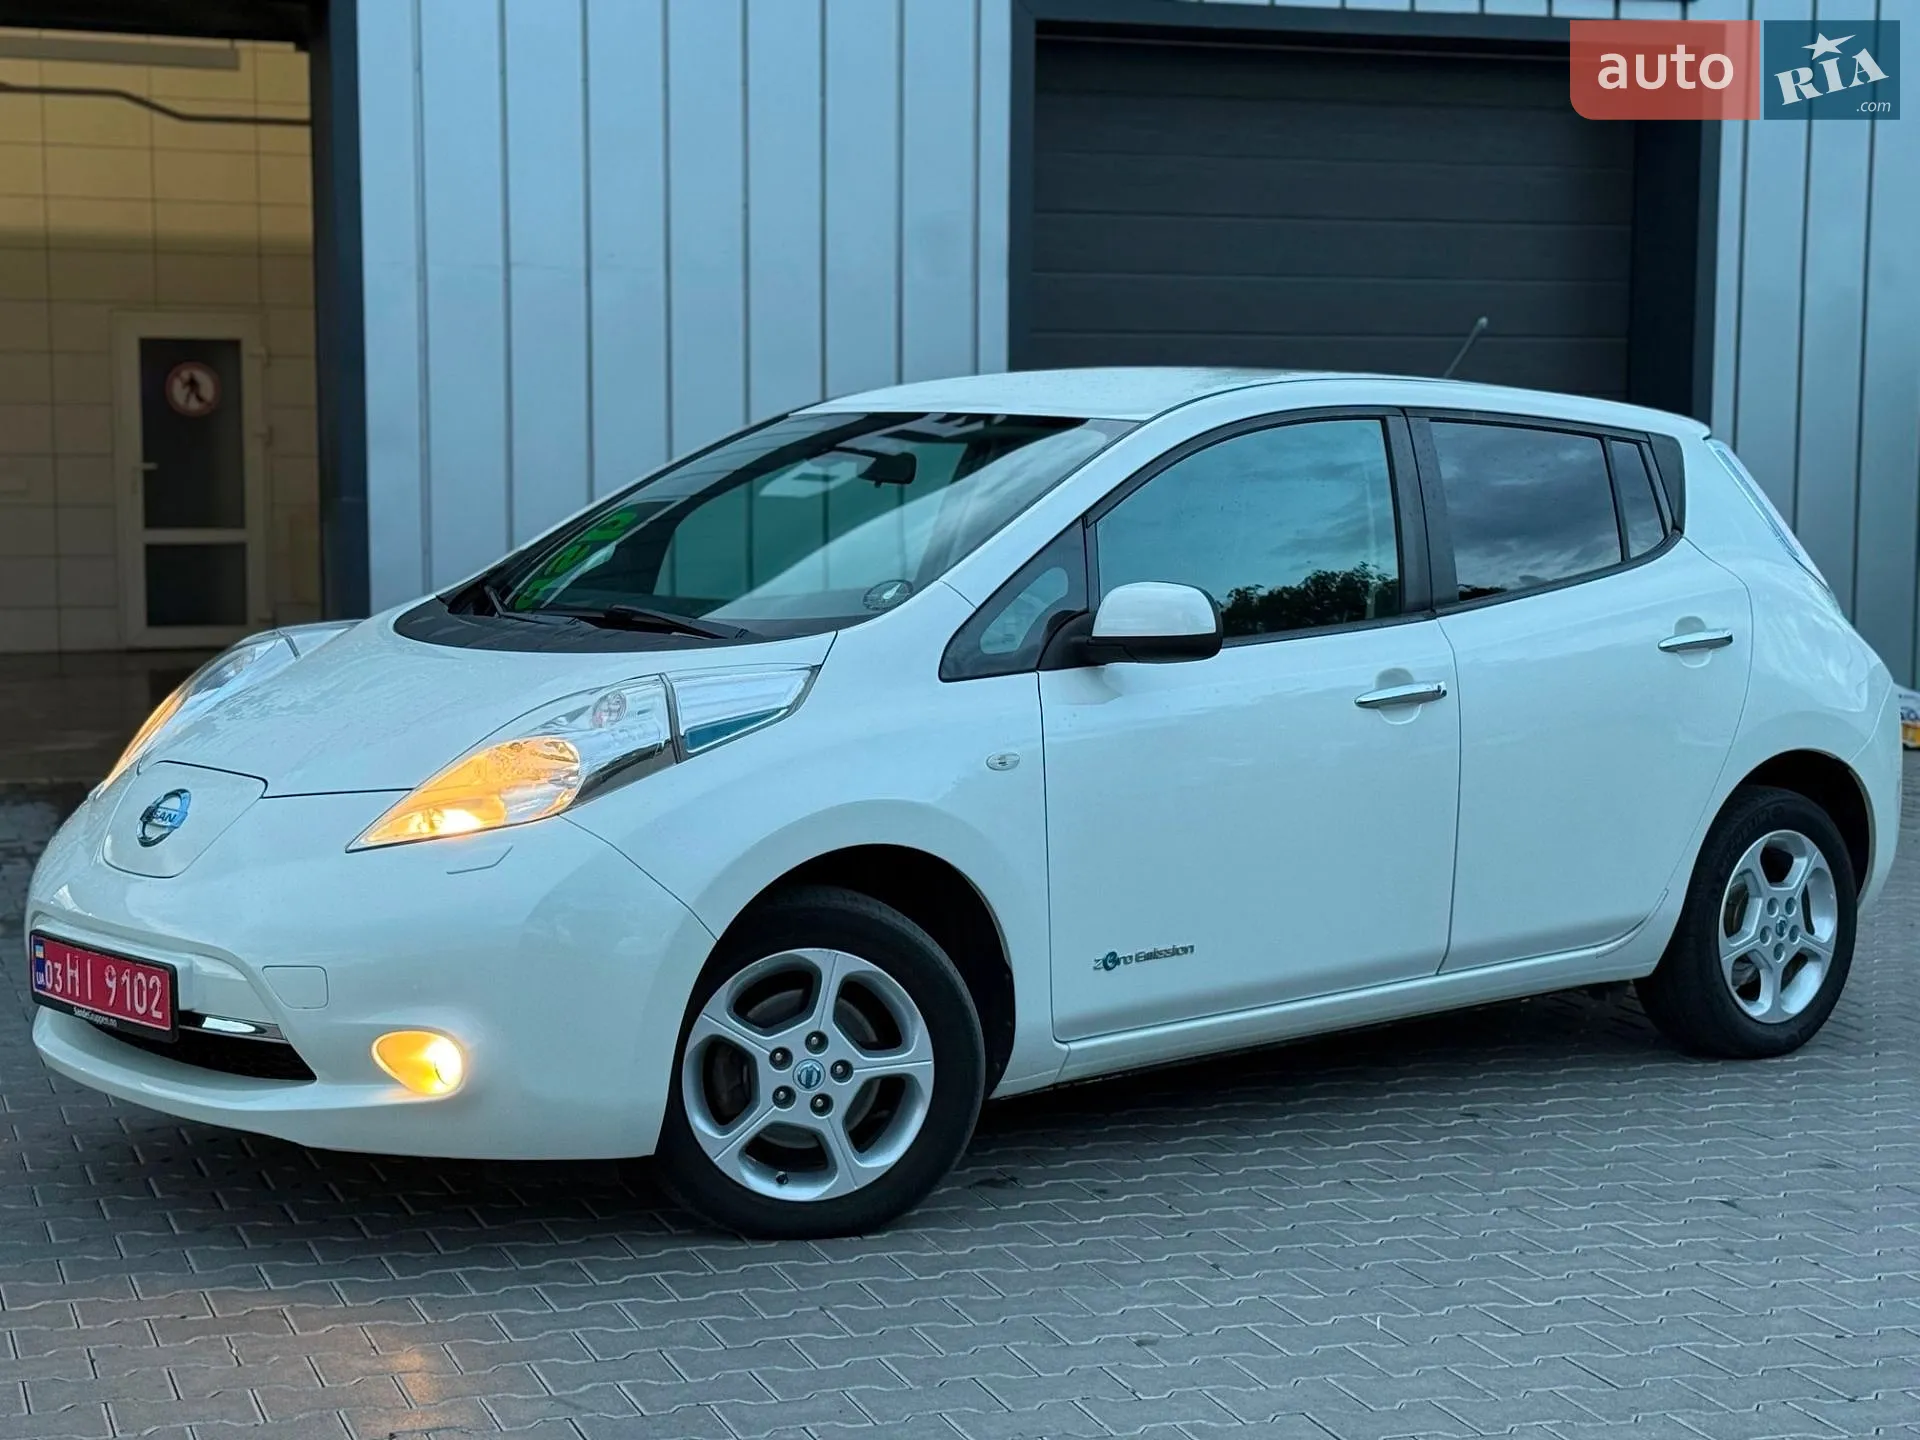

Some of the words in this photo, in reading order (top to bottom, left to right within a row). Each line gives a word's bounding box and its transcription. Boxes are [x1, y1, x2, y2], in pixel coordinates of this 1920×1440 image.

[1135, 944, 1195, 962] Emission
[36, 971, 45, 985] UA
[105, 964, 163, 1019] 9102
